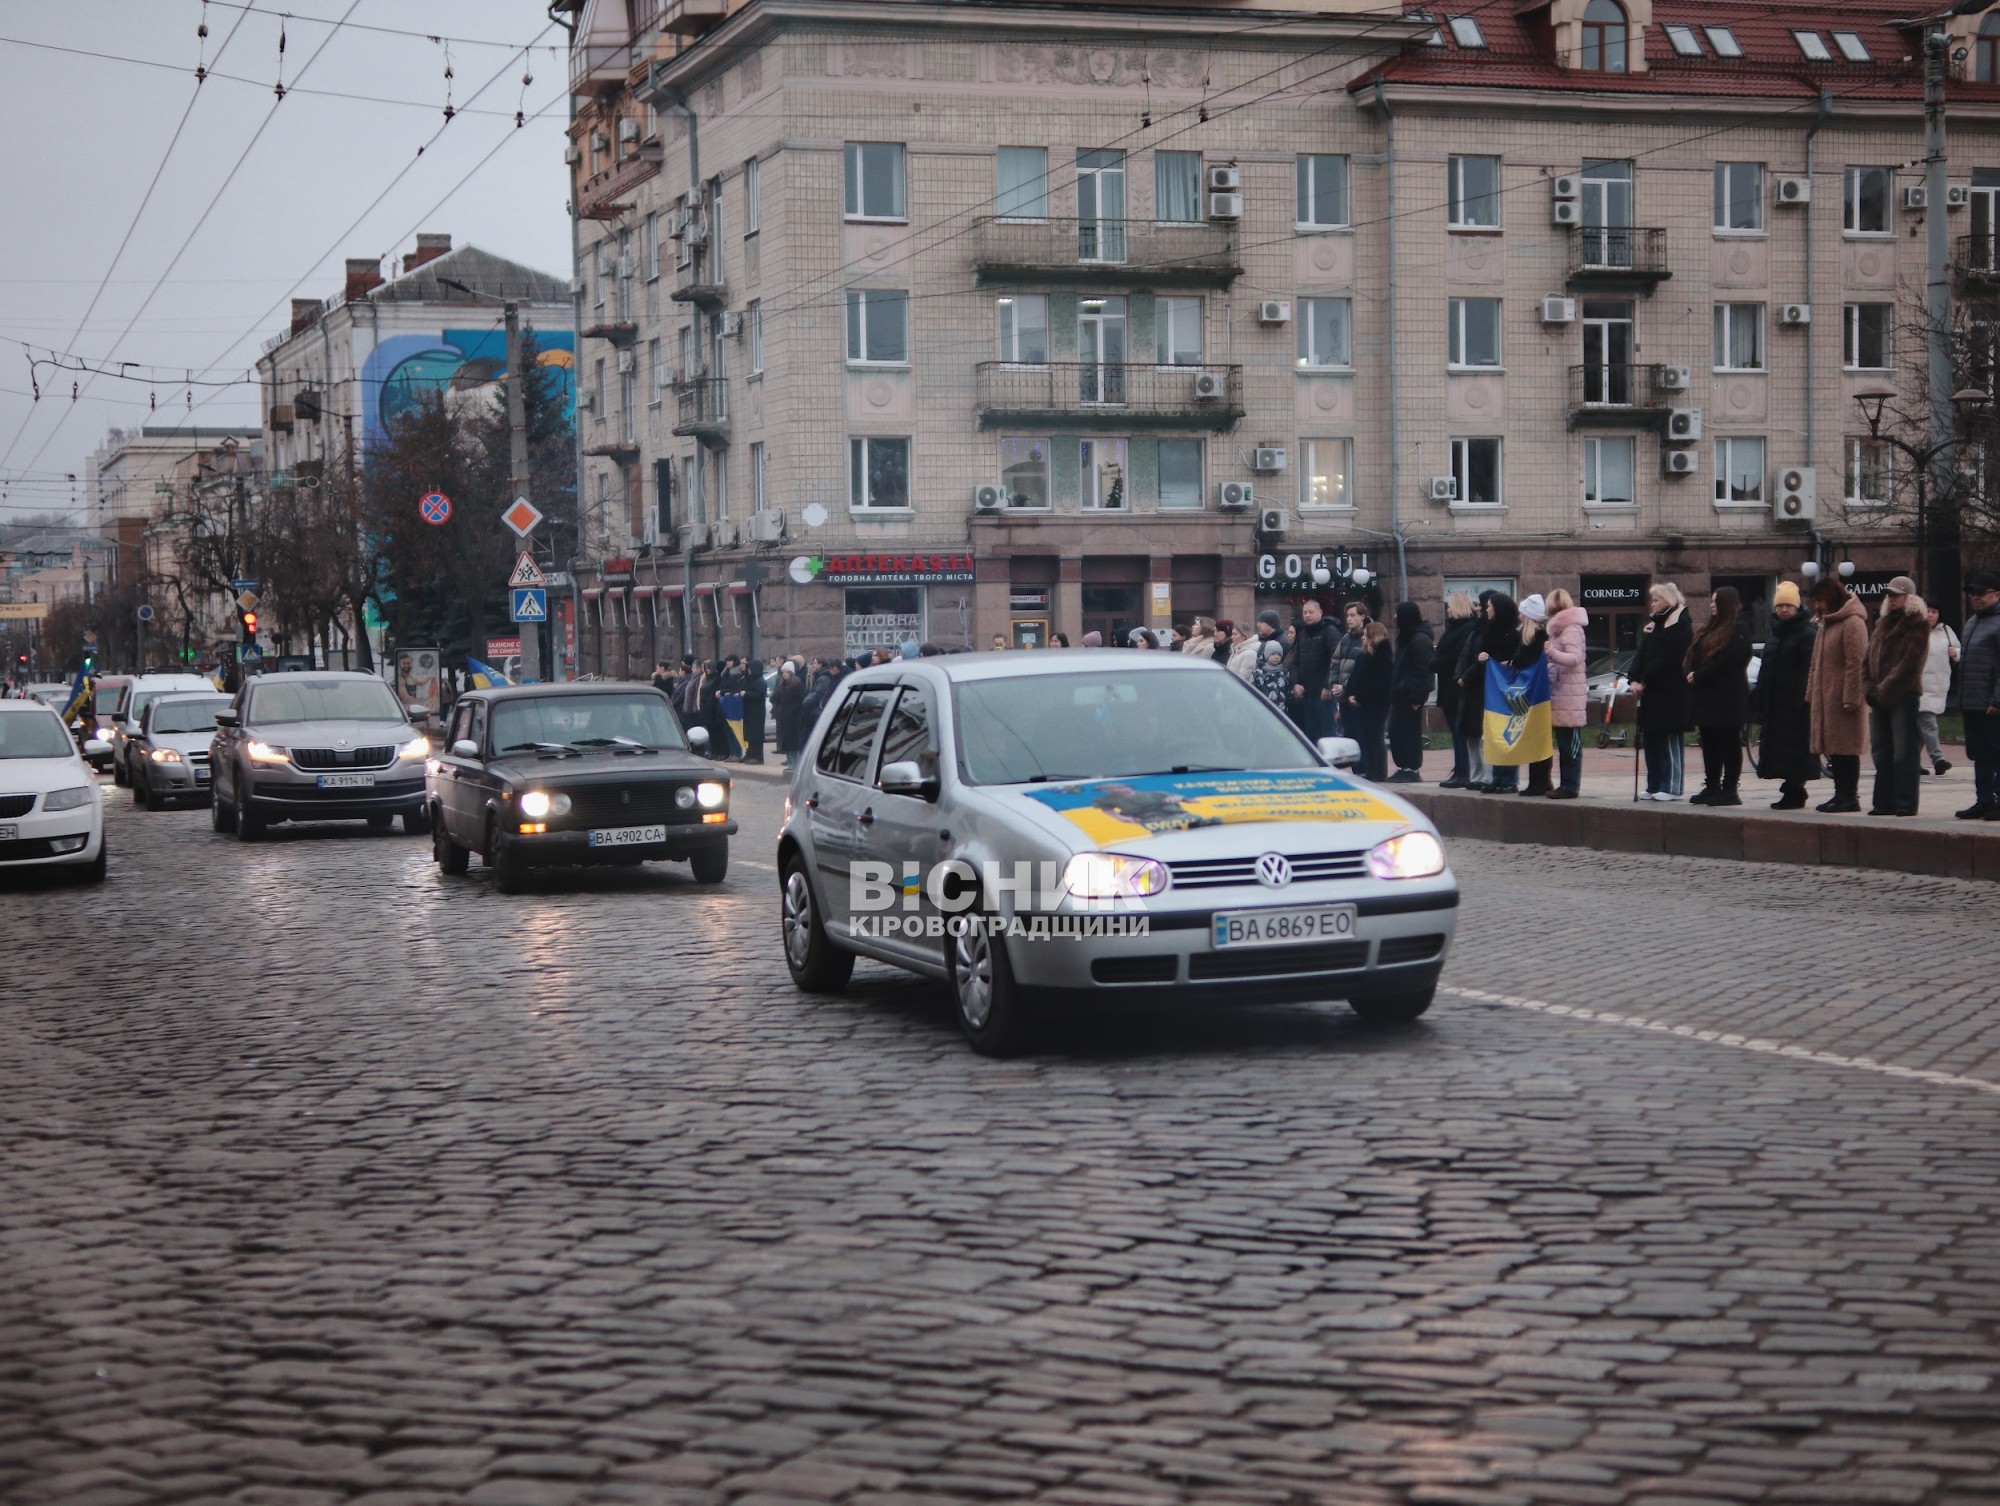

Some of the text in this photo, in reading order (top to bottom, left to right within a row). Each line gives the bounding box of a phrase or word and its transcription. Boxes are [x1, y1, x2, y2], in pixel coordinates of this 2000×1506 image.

[829, 555, 926, 573] АПТЕКА
[1260, 553, 1377, 579] GOGOL
[1585, 589, 1640, 598] CORNER_75
[596, 828, 661, 843] BA 4902 CA
[1229, 912, 1350, 941] BA 6869 EO
